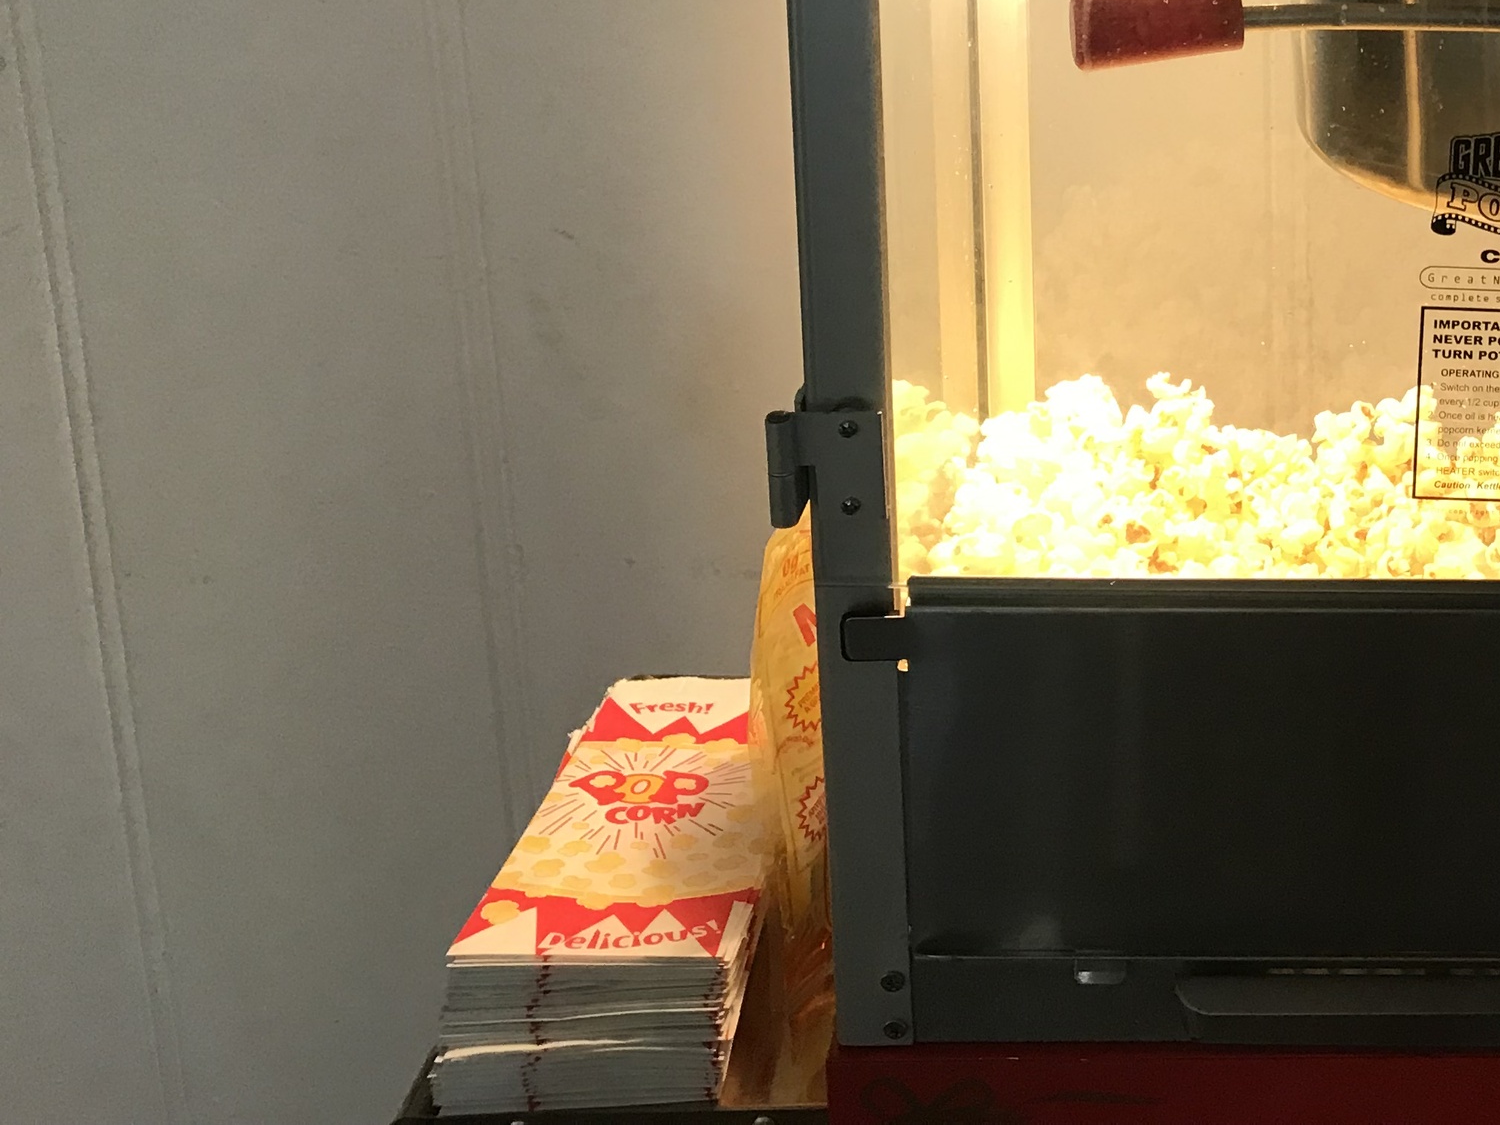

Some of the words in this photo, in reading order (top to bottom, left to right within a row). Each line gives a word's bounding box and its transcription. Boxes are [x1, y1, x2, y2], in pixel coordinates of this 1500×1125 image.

[1430, 293, 1490, 303] complete
[1432, 334, 1484, 345] NEVER
[1432, 348, 1474, 359] TURN
[1440, 368, 1500, 379] OPERATING
[1440, 382, 1470, 393] Switch
[1486, 384, 1500, 393] the
[1439, 399, 1464, 409] every
[1467, 398, 1481, 407] 1/2
[1483, 400, 1500, 408] cup
[1438, 411, 1463, 420] Once
[1465, 411, 1476, 420] oil
[1477, 413, 1486, 421] is
[1437, 426, 1474, 435] popcorn
[1437, 438, 1451, 448] Do
[1469, 441, 1500, 449] exceed
[1437, 452, 1461, 461] Once
[1462, 454, 1499, 464] popping
[1436, 466, 1476, 475] HEATER
[629, 702, 714, 715] Fresh!
[568, 770, 710, 806] POP
[604, 802, 706, 825] CORN
[537, 919, 722, 951] Delicious!
